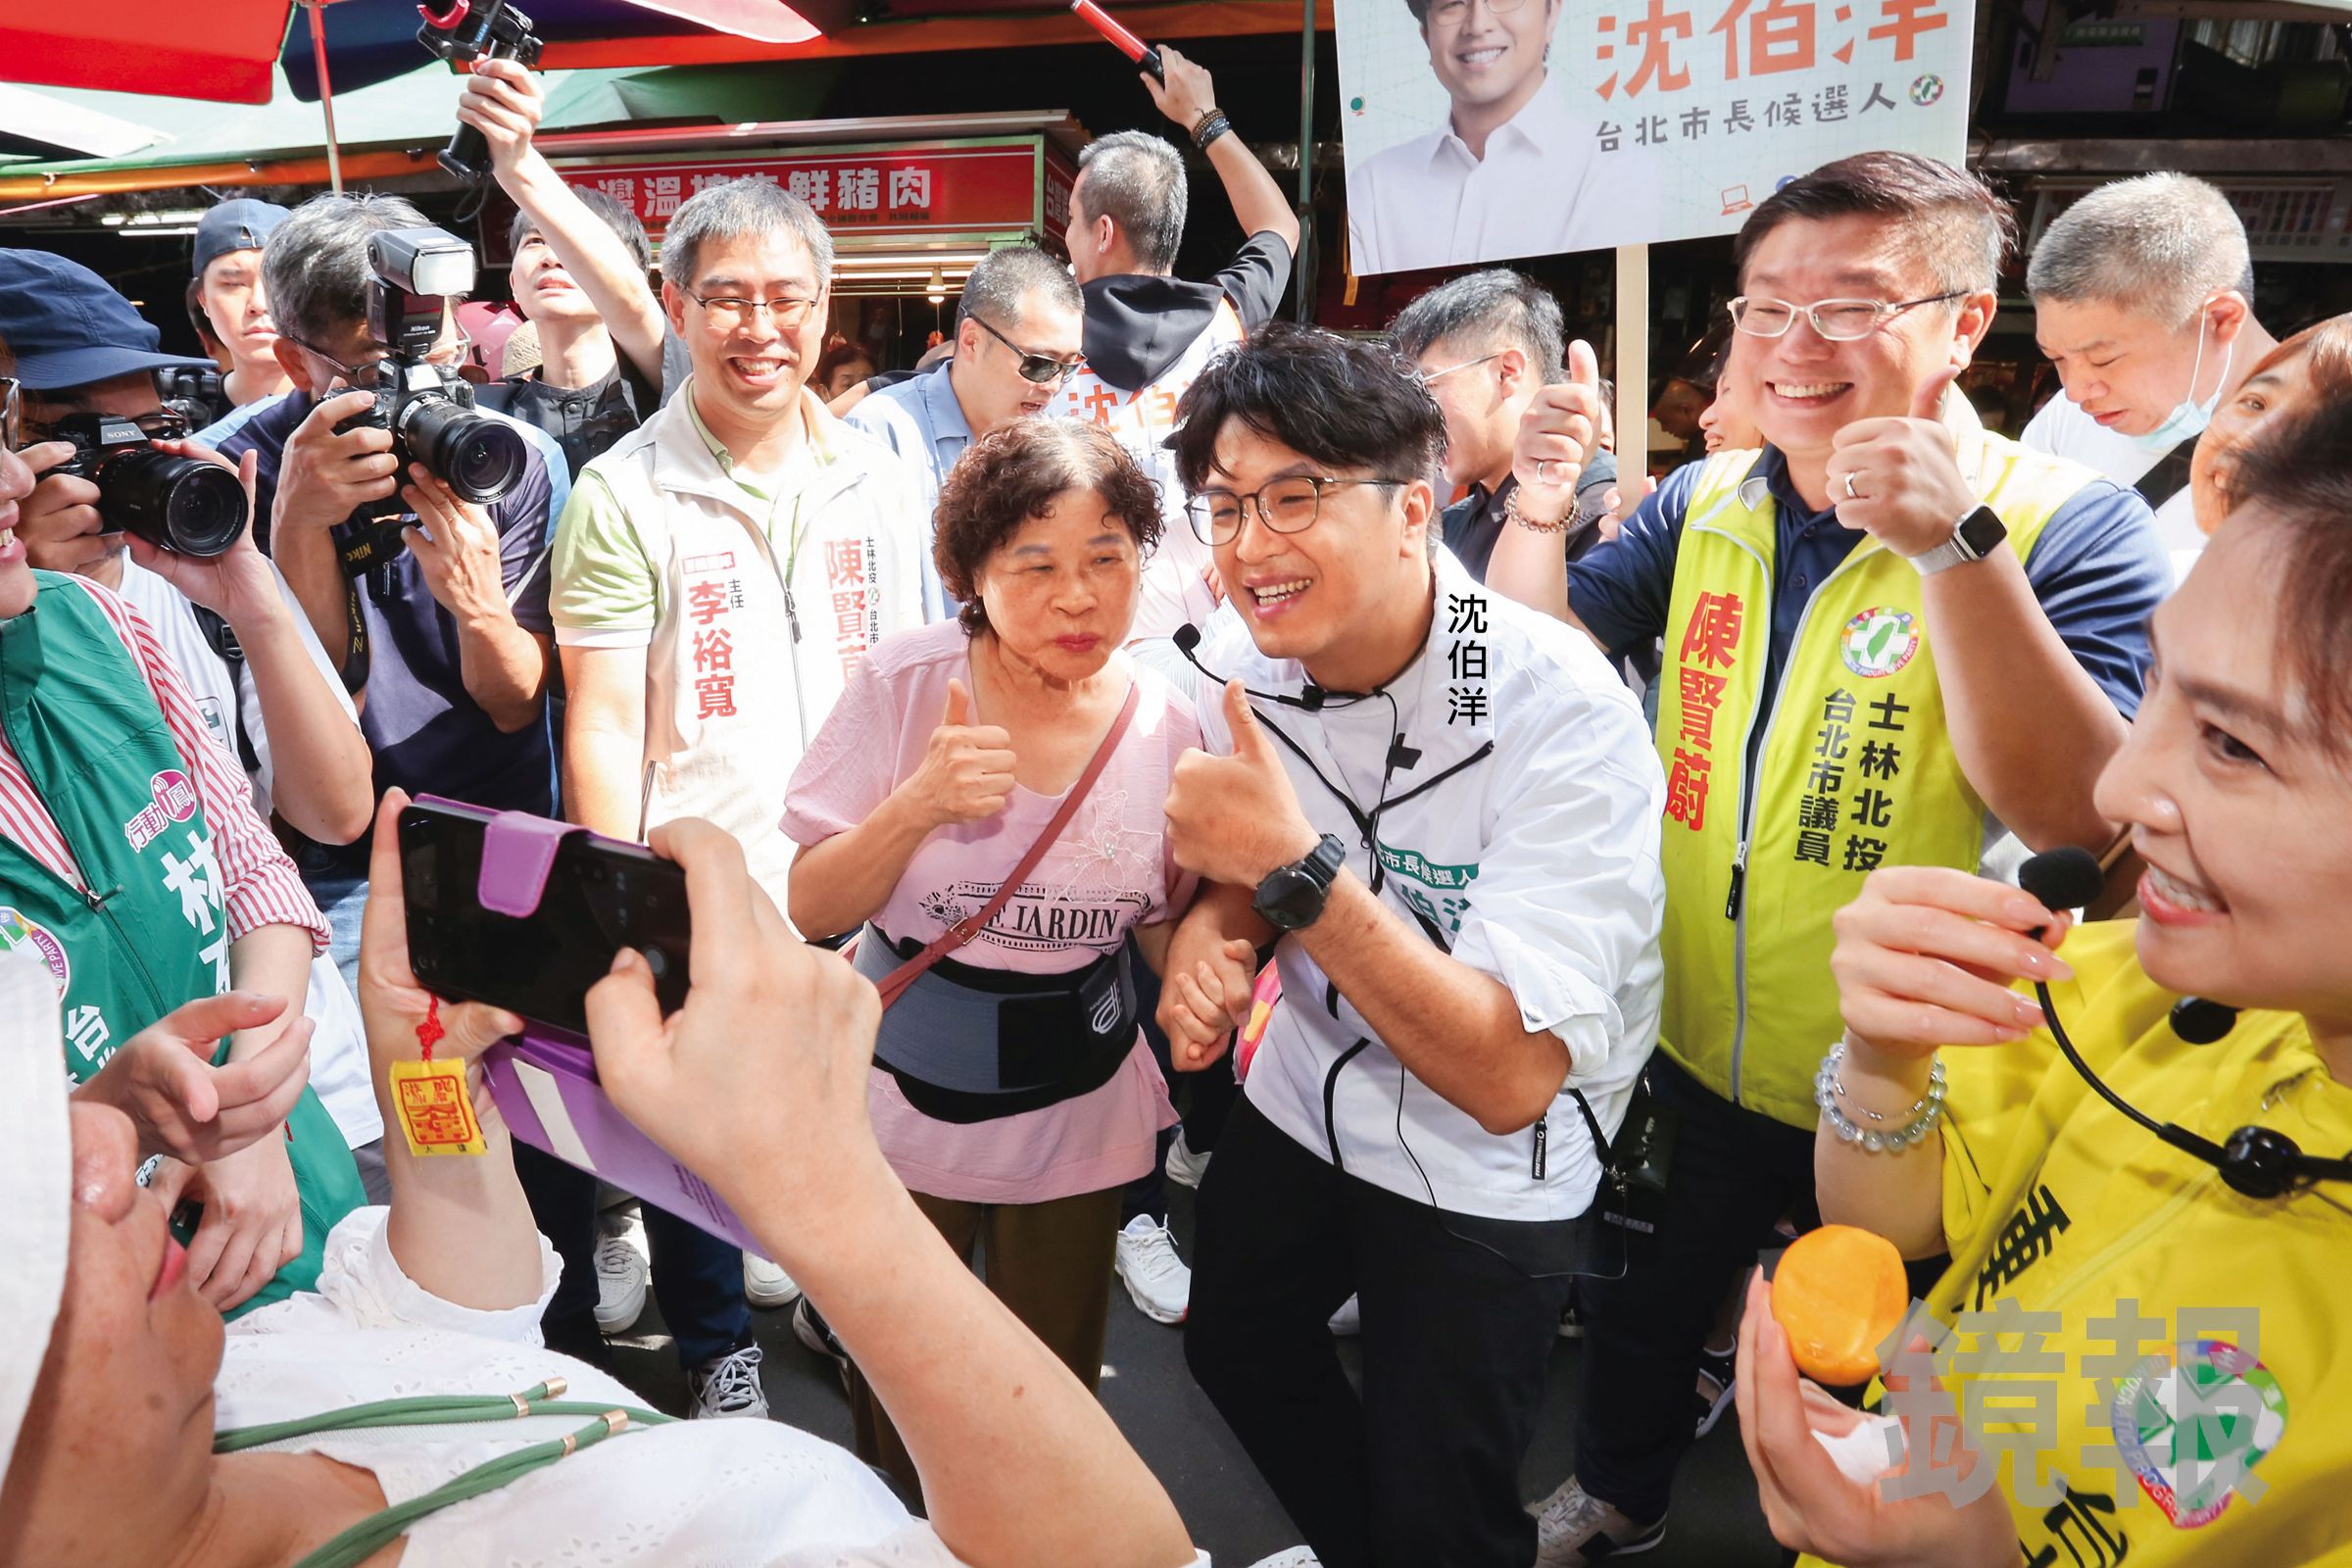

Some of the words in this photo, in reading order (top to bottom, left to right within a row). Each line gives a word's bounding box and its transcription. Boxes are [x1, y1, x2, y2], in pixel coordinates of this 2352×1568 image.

[1595, 82, 1897, 153] 台北市長候選人
[107, 429, 135, 438] SONY
[728, 578, 745, 610] 主任
[688, 580, 738, 720] 李裕寬
[1663, 591, 1743, 832] 陳賢蔚
[1793, 688, 1858, 867] 台北市議員
[1842, 692, 1910, 872] 士林北投
[1011, 905, 1121, 940] JARDIN
